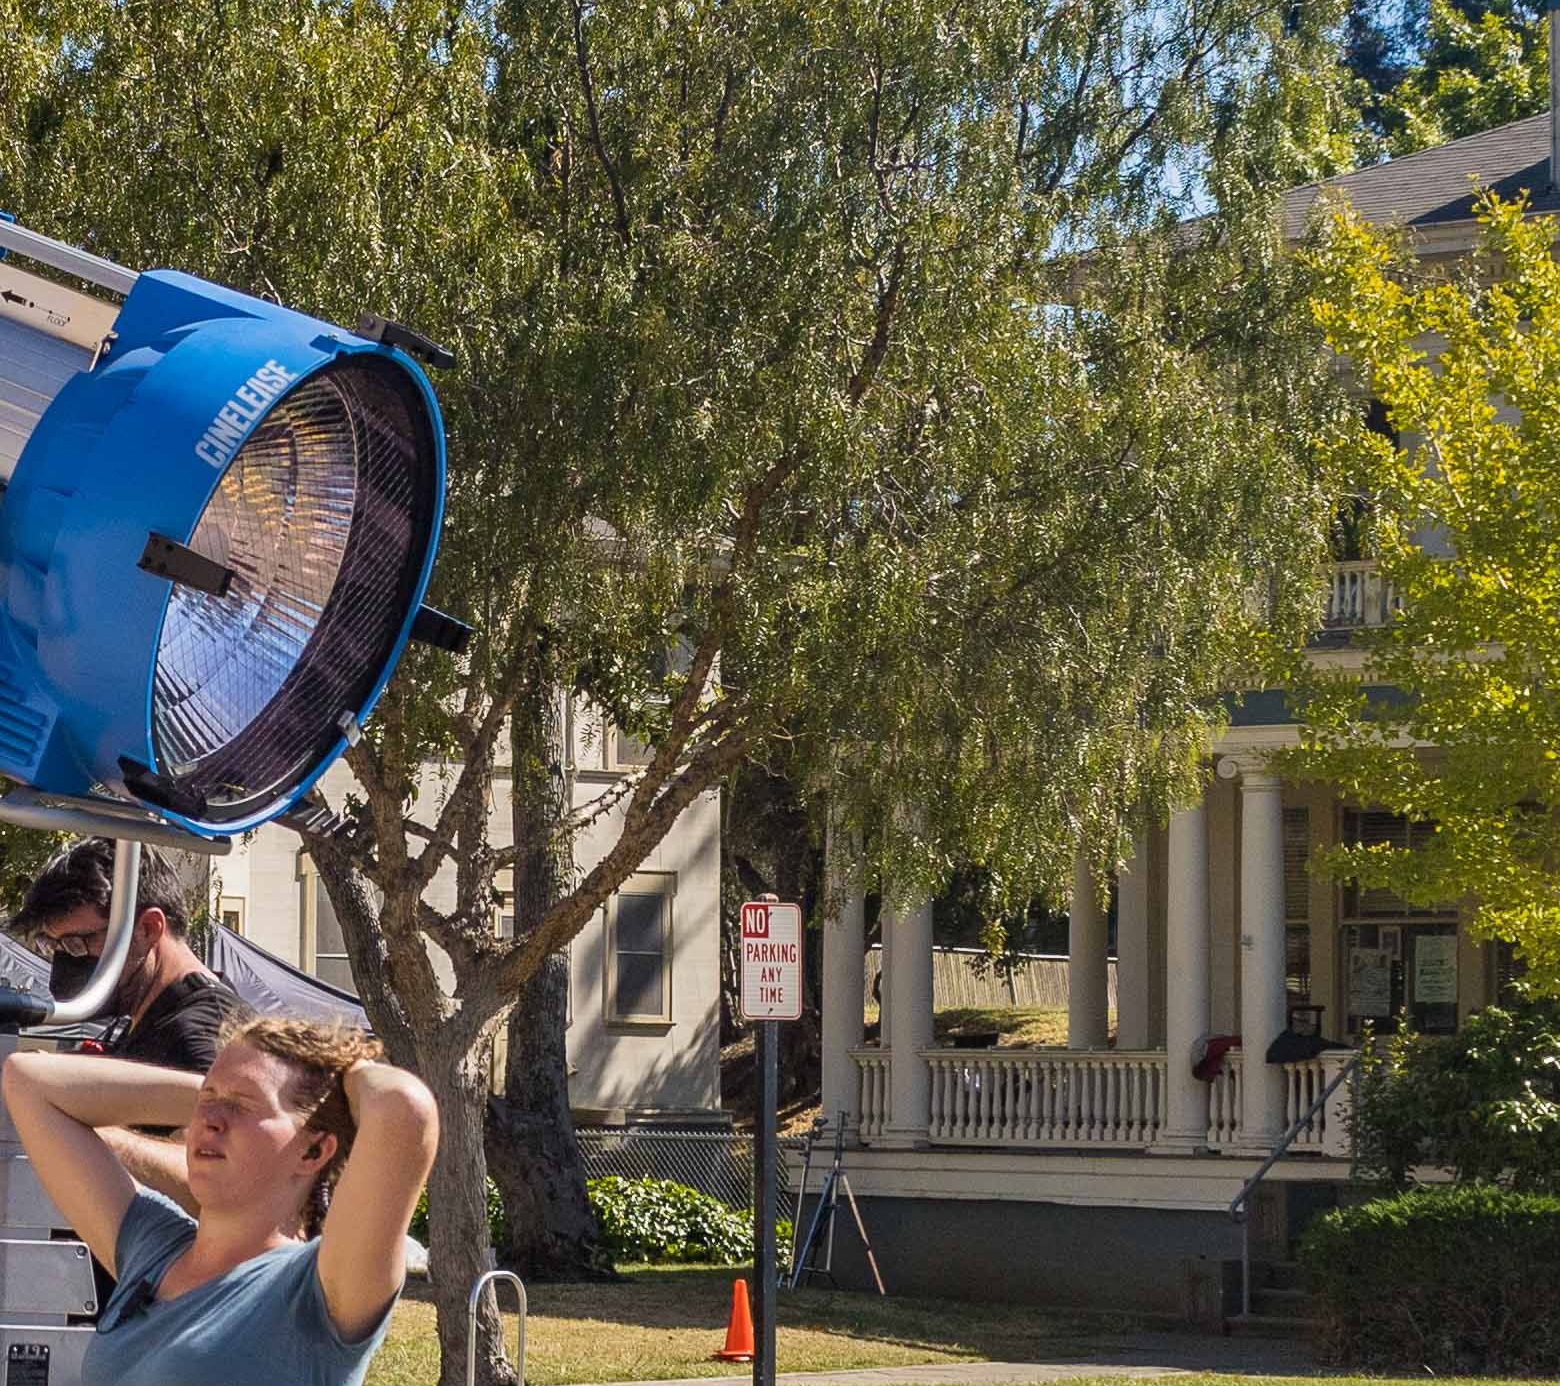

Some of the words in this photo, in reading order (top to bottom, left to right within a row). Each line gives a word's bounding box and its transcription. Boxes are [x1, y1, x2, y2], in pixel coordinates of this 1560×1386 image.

[195, 359, 299, 469] CINELEASE
[746, 908, 766, 934] NO
[746, 943, 797, 964] PARKING
[760, 966, 783, 983] ANY
[760, 987, 784, 1004] TIME
